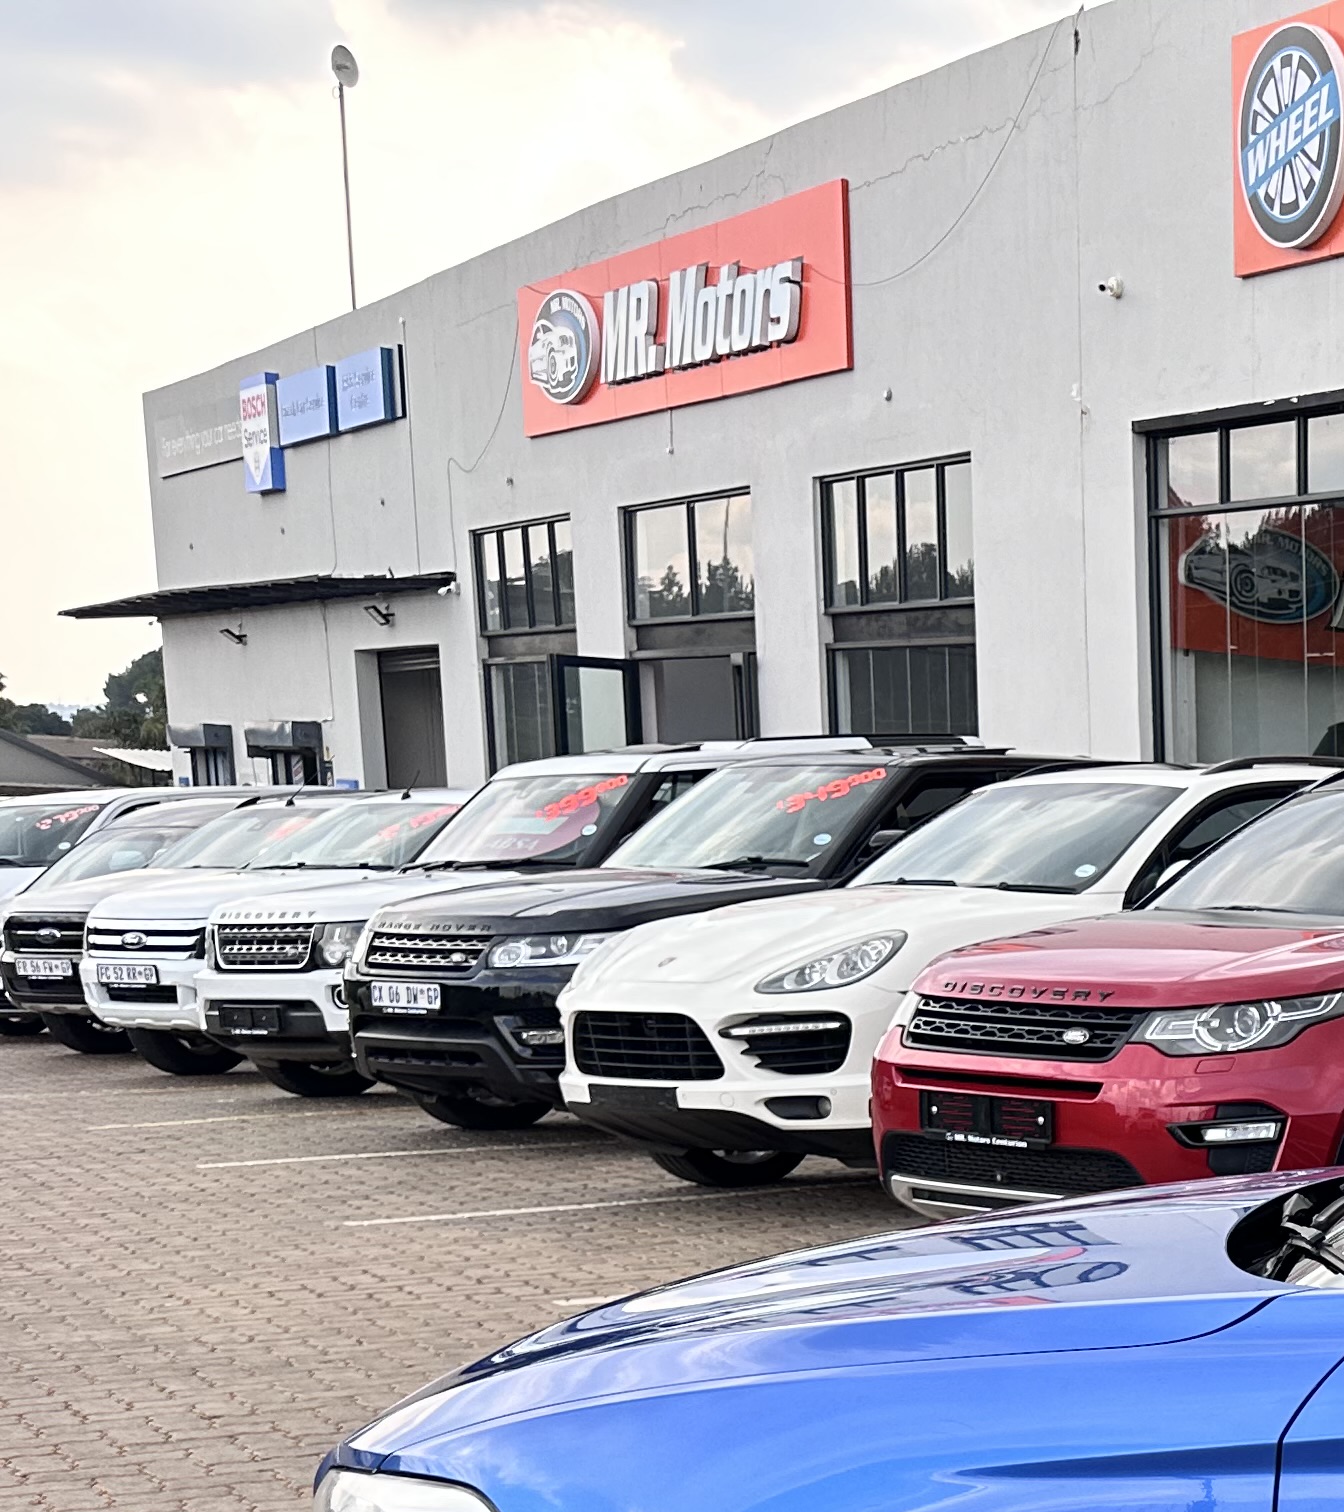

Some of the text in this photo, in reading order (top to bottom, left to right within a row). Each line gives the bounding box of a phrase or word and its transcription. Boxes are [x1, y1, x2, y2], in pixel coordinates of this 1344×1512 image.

[1247, 82, 1335, 188] WHEEL
[664, 256, 804, 370] Motors
[241, 394, 267, 421] BOSCH
[243, 428, 268, 449] Service
[218, 909, 318, 920] DISCOVERY
[377, 920, 423, 931] RANGE
[143, 966, 154, 981] GP
[372, 985, 384, 1003] CX
[389, 985, 401, 1004] 06
[426, 987, 439, 1006] GP
[942, 980, 1116, 1003] DISCOVERY
